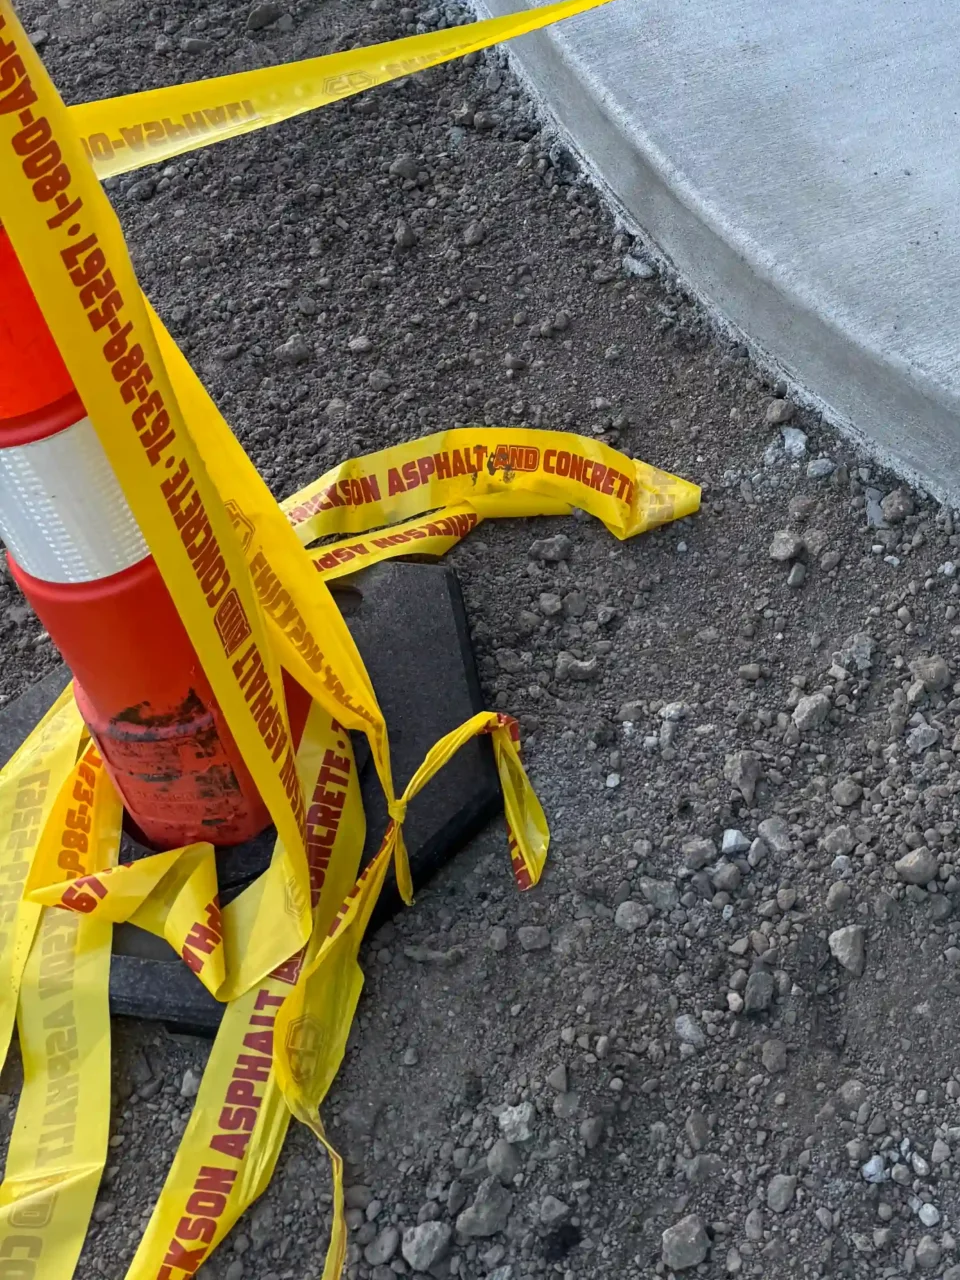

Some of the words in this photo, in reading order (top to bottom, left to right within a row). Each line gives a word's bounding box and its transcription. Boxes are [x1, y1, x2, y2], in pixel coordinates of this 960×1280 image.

[60, 232, 176, 468] 763-389-5267
[387, 445, 486, 497] ASPHALT
[493, 444, 541, 472] AND
[160, 458, 231, 609] CONCRETE
[370, 512, 478, 549] ERICKSON
[213, 587, 252, 659] AND
[232, 642, 289, 763] ASPHALT
